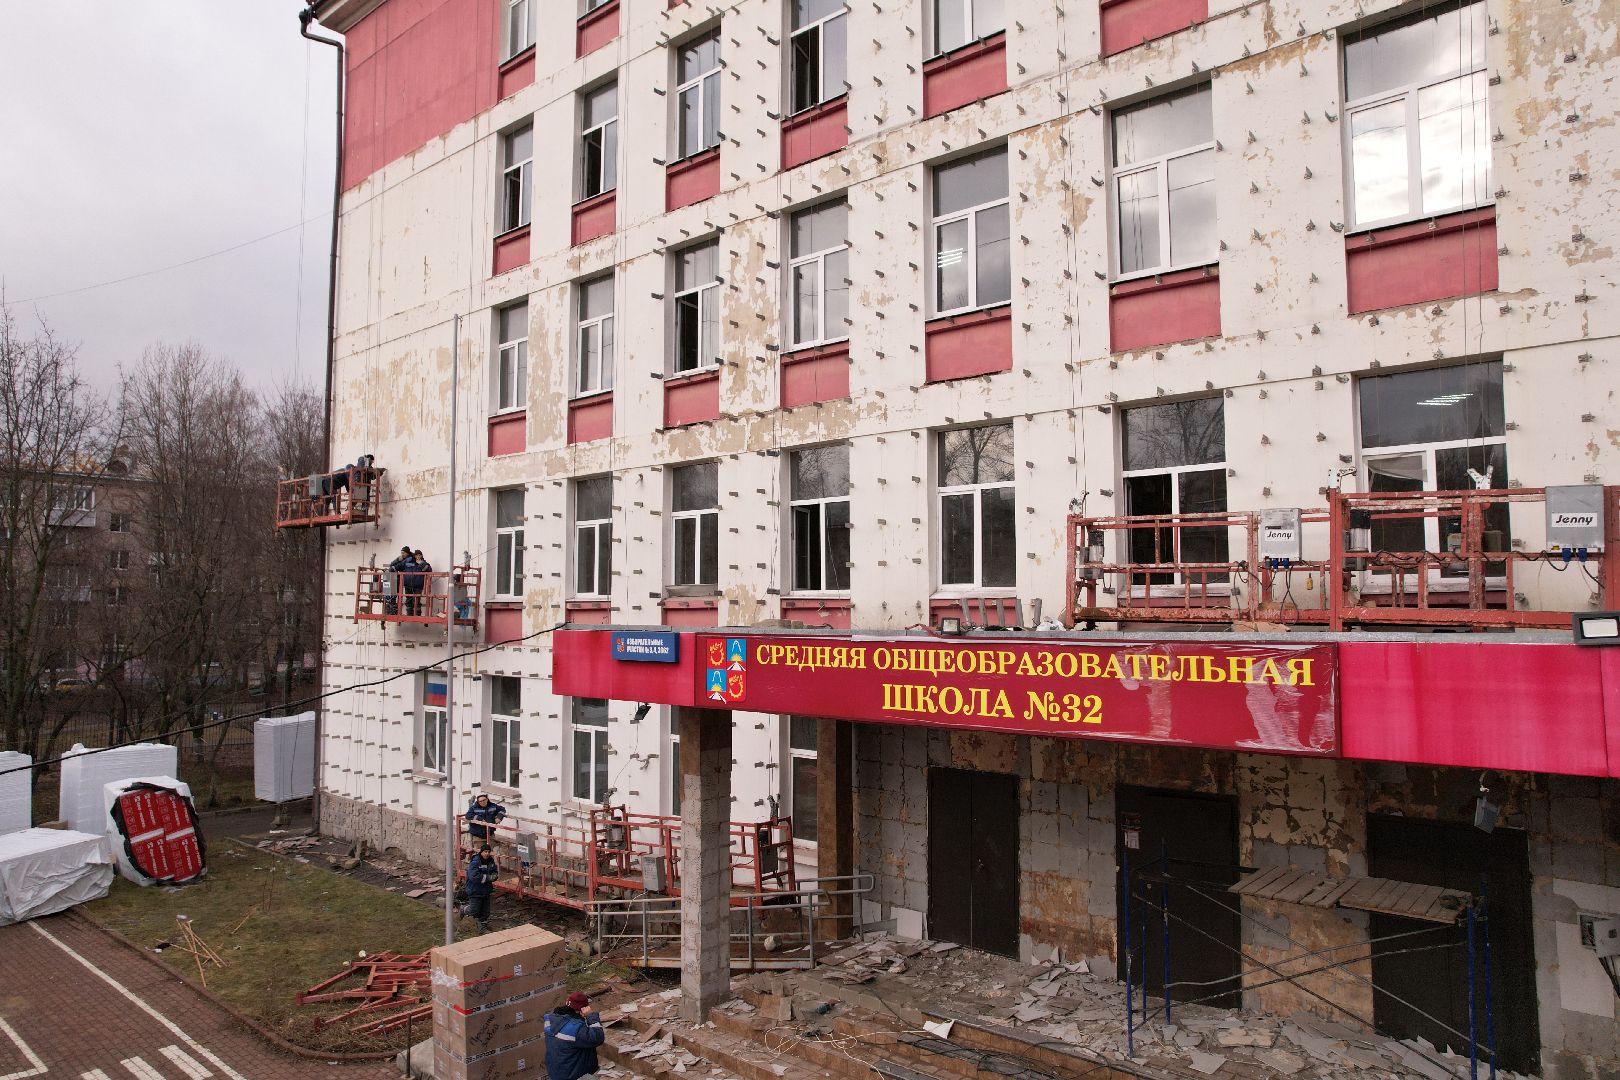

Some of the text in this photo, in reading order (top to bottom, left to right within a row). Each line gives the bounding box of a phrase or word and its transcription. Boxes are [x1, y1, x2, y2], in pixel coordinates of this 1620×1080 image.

[1555, 514, 1593, 525] Jenny
[1267, 531, 1292, 540] Jenny
[756, 644, 1315, 687] СРЕДНЯЯ ОБЩЕОБРАЗОВАТЕЛЬНАЯ
[882, 683, 1103, 724] ШКОЛА №32
